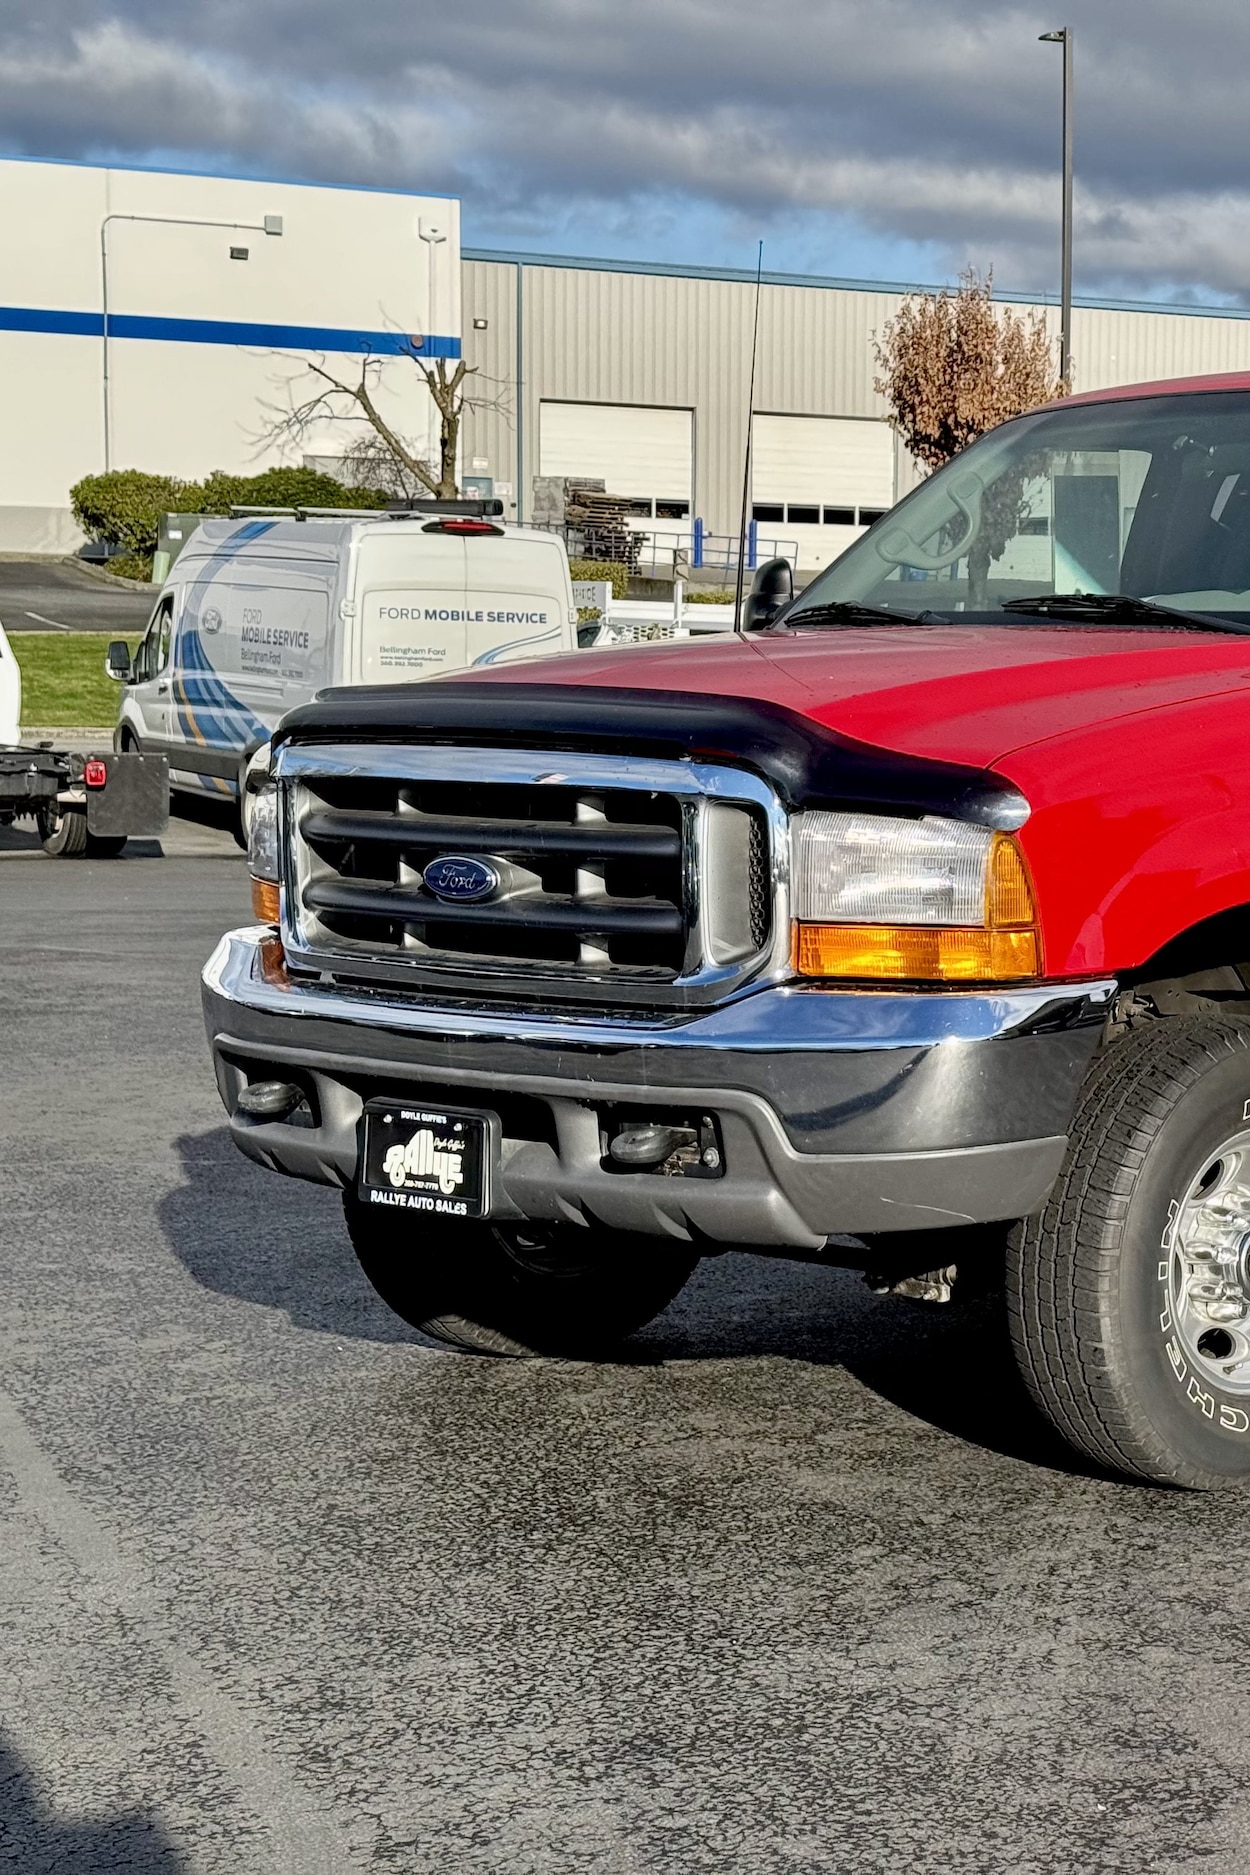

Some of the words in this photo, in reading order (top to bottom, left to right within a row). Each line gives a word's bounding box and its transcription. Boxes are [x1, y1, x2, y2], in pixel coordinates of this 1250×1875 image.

[243, 608, 262, 624] FORD
[379, 607, 421, 620] FORD
[424, 609, 484, 622] MOBILE
[486, 611, 548, 624] SERVICE
[241, 626, 271, 645] MOBILE
[272, 629, 309, 649] SERVICE
[379, 645, 426, 656] Bellingham
[427, 647, 446, 656] Ford
[438, 863, 477, 890] Ford
[369, 1189, 407, 1207] RALLYE
[406, 1194, 435, 1211] AUTO
[435, 1199, 468, 1216] SALES
